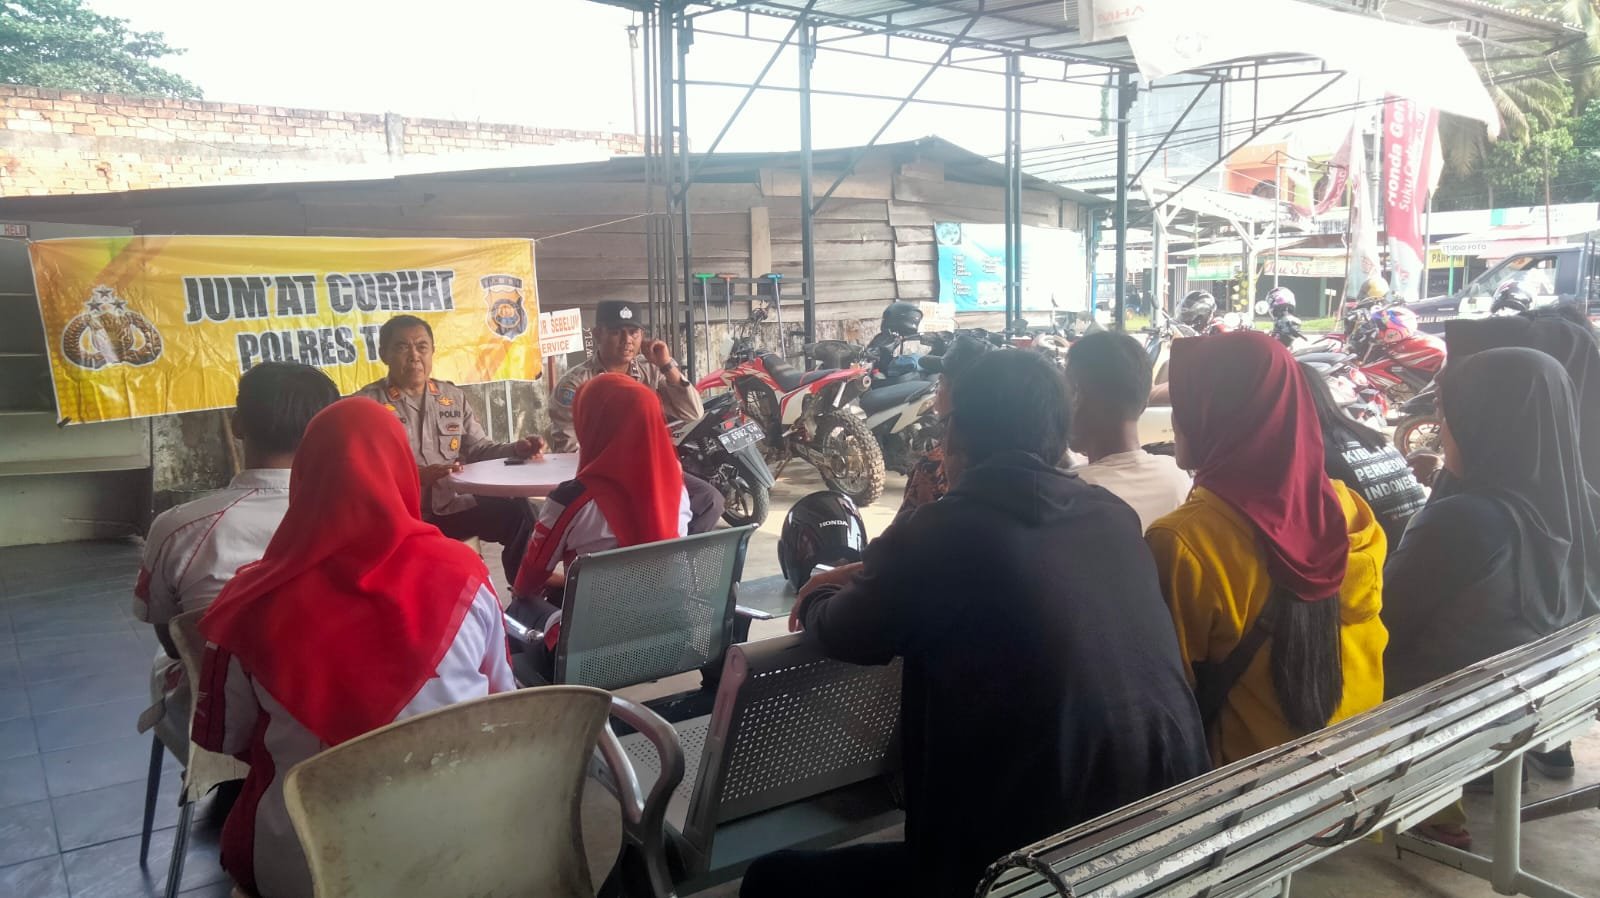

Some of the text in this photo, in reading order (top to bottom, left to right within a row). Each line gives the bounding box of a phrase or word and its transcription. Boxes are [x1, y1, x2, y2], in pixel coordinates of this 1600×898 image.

[184, 270, 454, 322] JUM'AT CURHAT
[551, 315, 579, 333] SEBELUM
[236, 325, 358, 374] POLRES
[542, 340, 569, 353] ERVICE
[439, 410, 461, 418] POLRI
[1364, 474, 1417, 500] INDONES
[818, 519, 848, 528] HONDA
